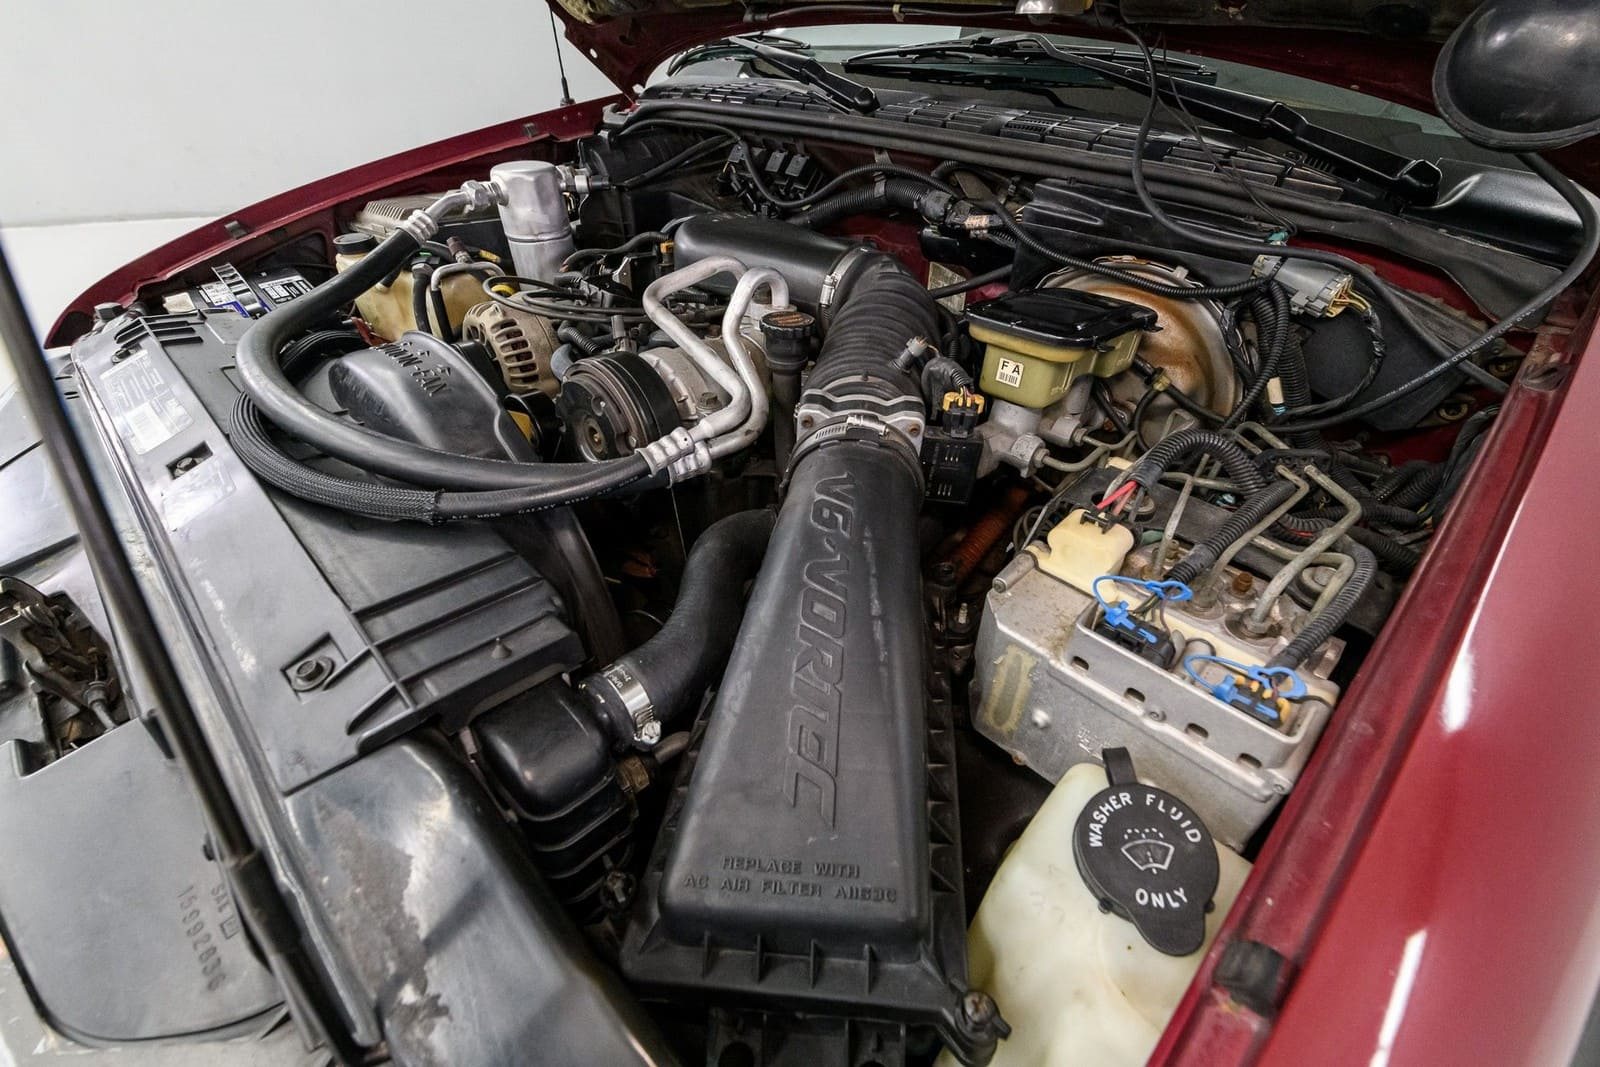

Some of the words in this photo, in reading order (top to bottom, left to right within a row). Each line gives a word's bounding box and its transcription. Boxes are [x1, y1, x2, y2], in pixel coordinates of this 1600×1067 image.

[1088, 791, 1133, 848] WASHER
[1145, 793, 1202, 843] FLUID
[722, 856, 802, 875] REPLACE
[814, 861, 861, 879] WITH
[684, 874, 710, 889] AC
[721, 877, 750, 892] AIR
[761, 879, 822, 898] FILTER
[1135, 887, 1188, 909] ONLY
